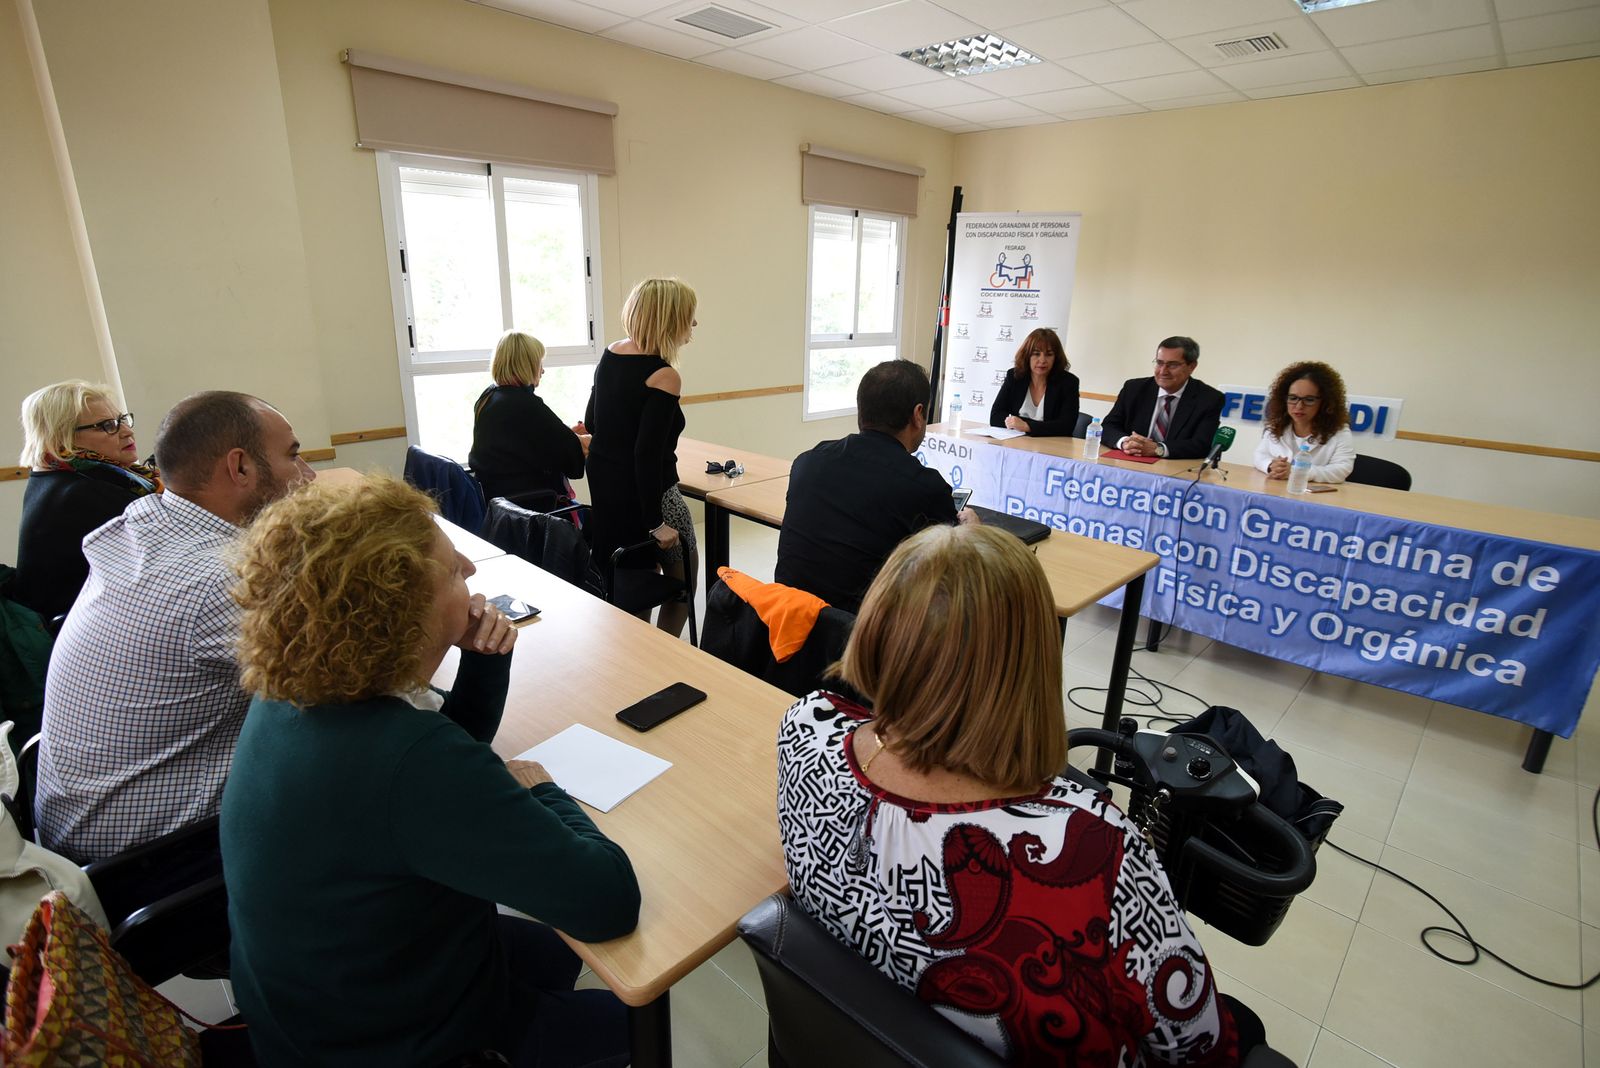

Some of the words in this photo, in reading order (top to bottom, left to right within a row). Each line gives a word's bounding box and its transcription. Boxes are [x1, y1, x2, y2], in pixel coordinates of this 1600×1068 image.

[920, 436, 973, 461] GRADI
[1222, 392, 1389, 434] FEDI
[1046, 469, 1228, 530] Federación
[1240, 508, 1473, 580] Granadina
[1491, 555, 1561, 592] de
[1154, 535, 1218, 569] con
[1230, 547, 1548, 640] Discapacidad
[1156, 567, 1261, 622] Física
[1270, 606, 1298, 635] y
[1310, 611, 1527, 687] Orgánica
